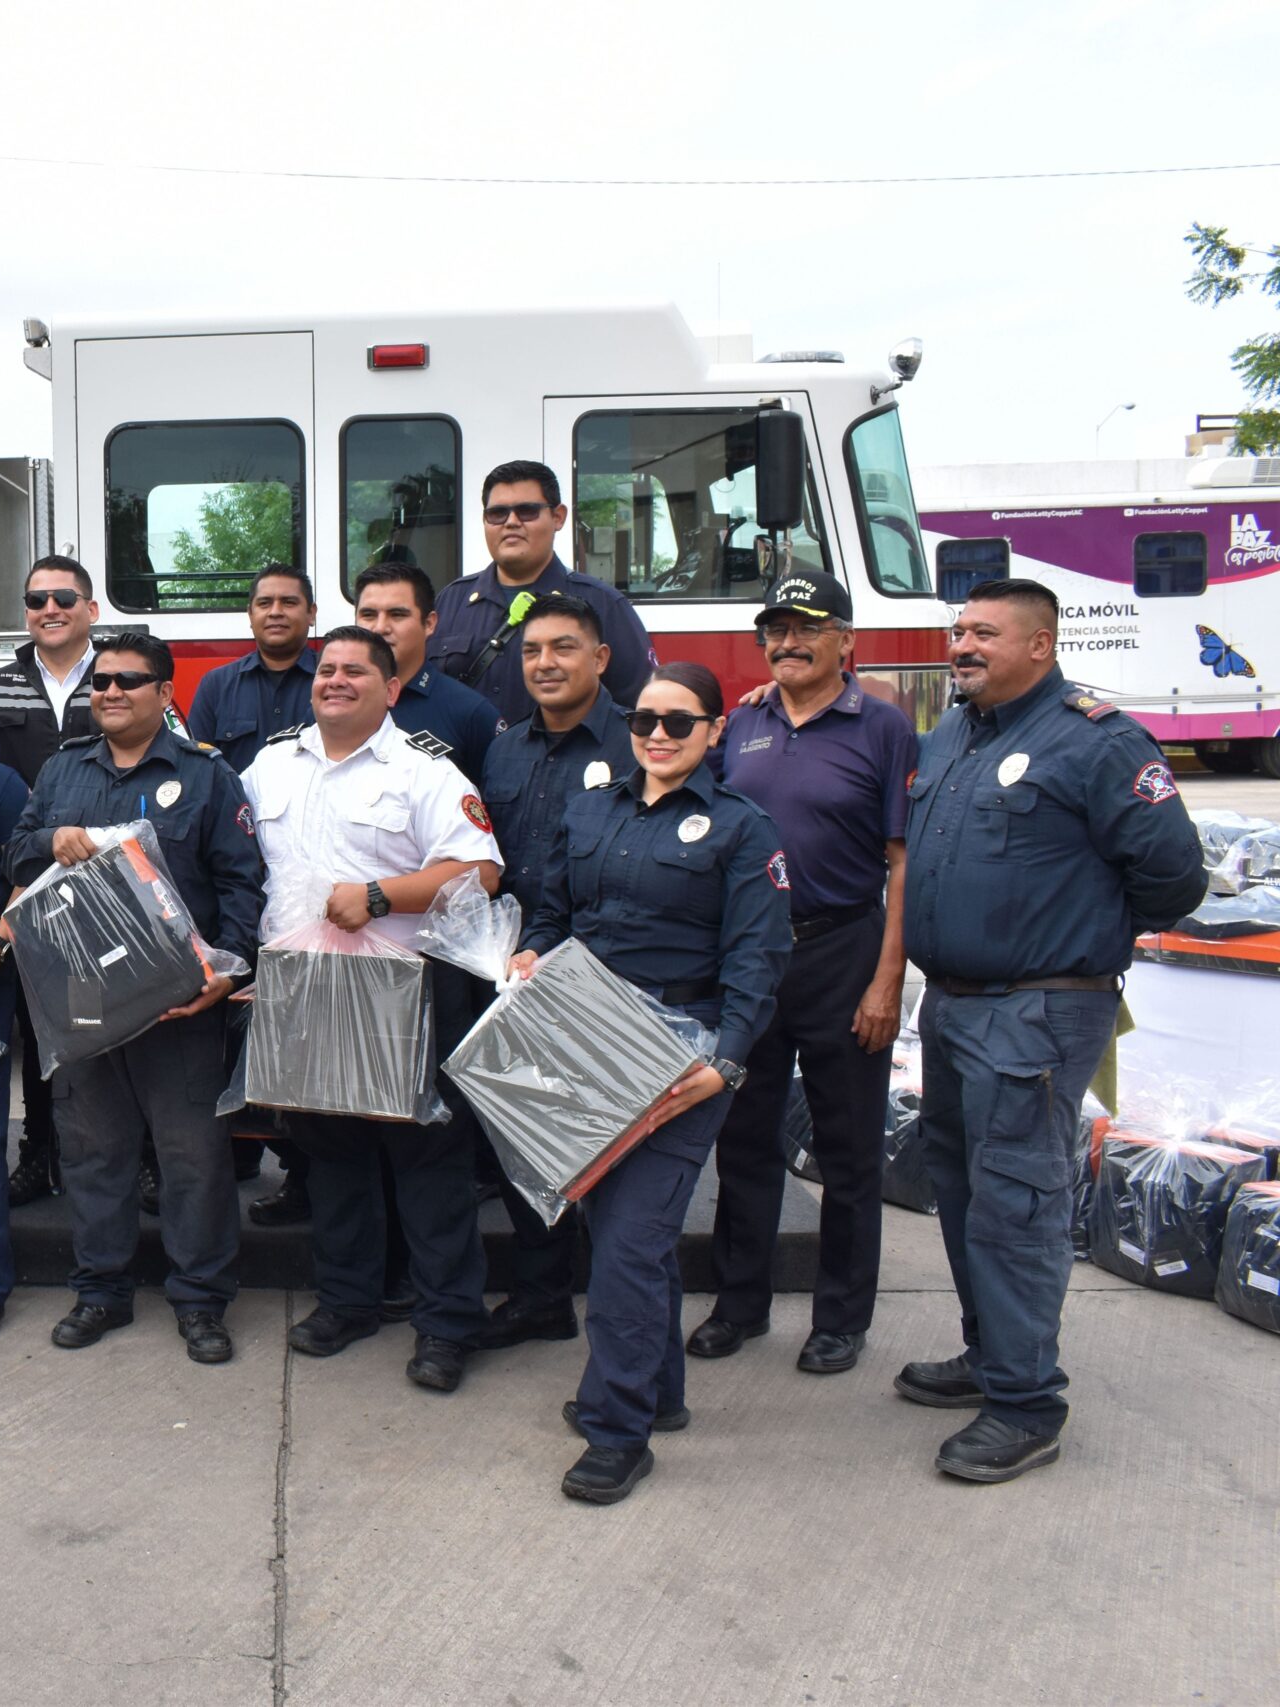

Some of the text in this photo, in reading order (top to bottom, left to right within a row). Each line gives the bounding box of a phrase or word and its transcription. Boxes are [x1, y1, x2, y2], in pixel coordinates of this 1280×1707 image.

[1231, 513, 1259, 531] LA
[1231, 531, 1272, 548] PAZ
[1231, 545, 1280, 566] es posibl
[776, 579, 817, 595] BOMBEROS
[776, 591, 811, 603] LA PAZ
[1089, 602, 1139, 617] MÓVIL
[1102, 625, 1141, 634] SOCIAL
[1087, 639, 1140, 650] COPPEL
